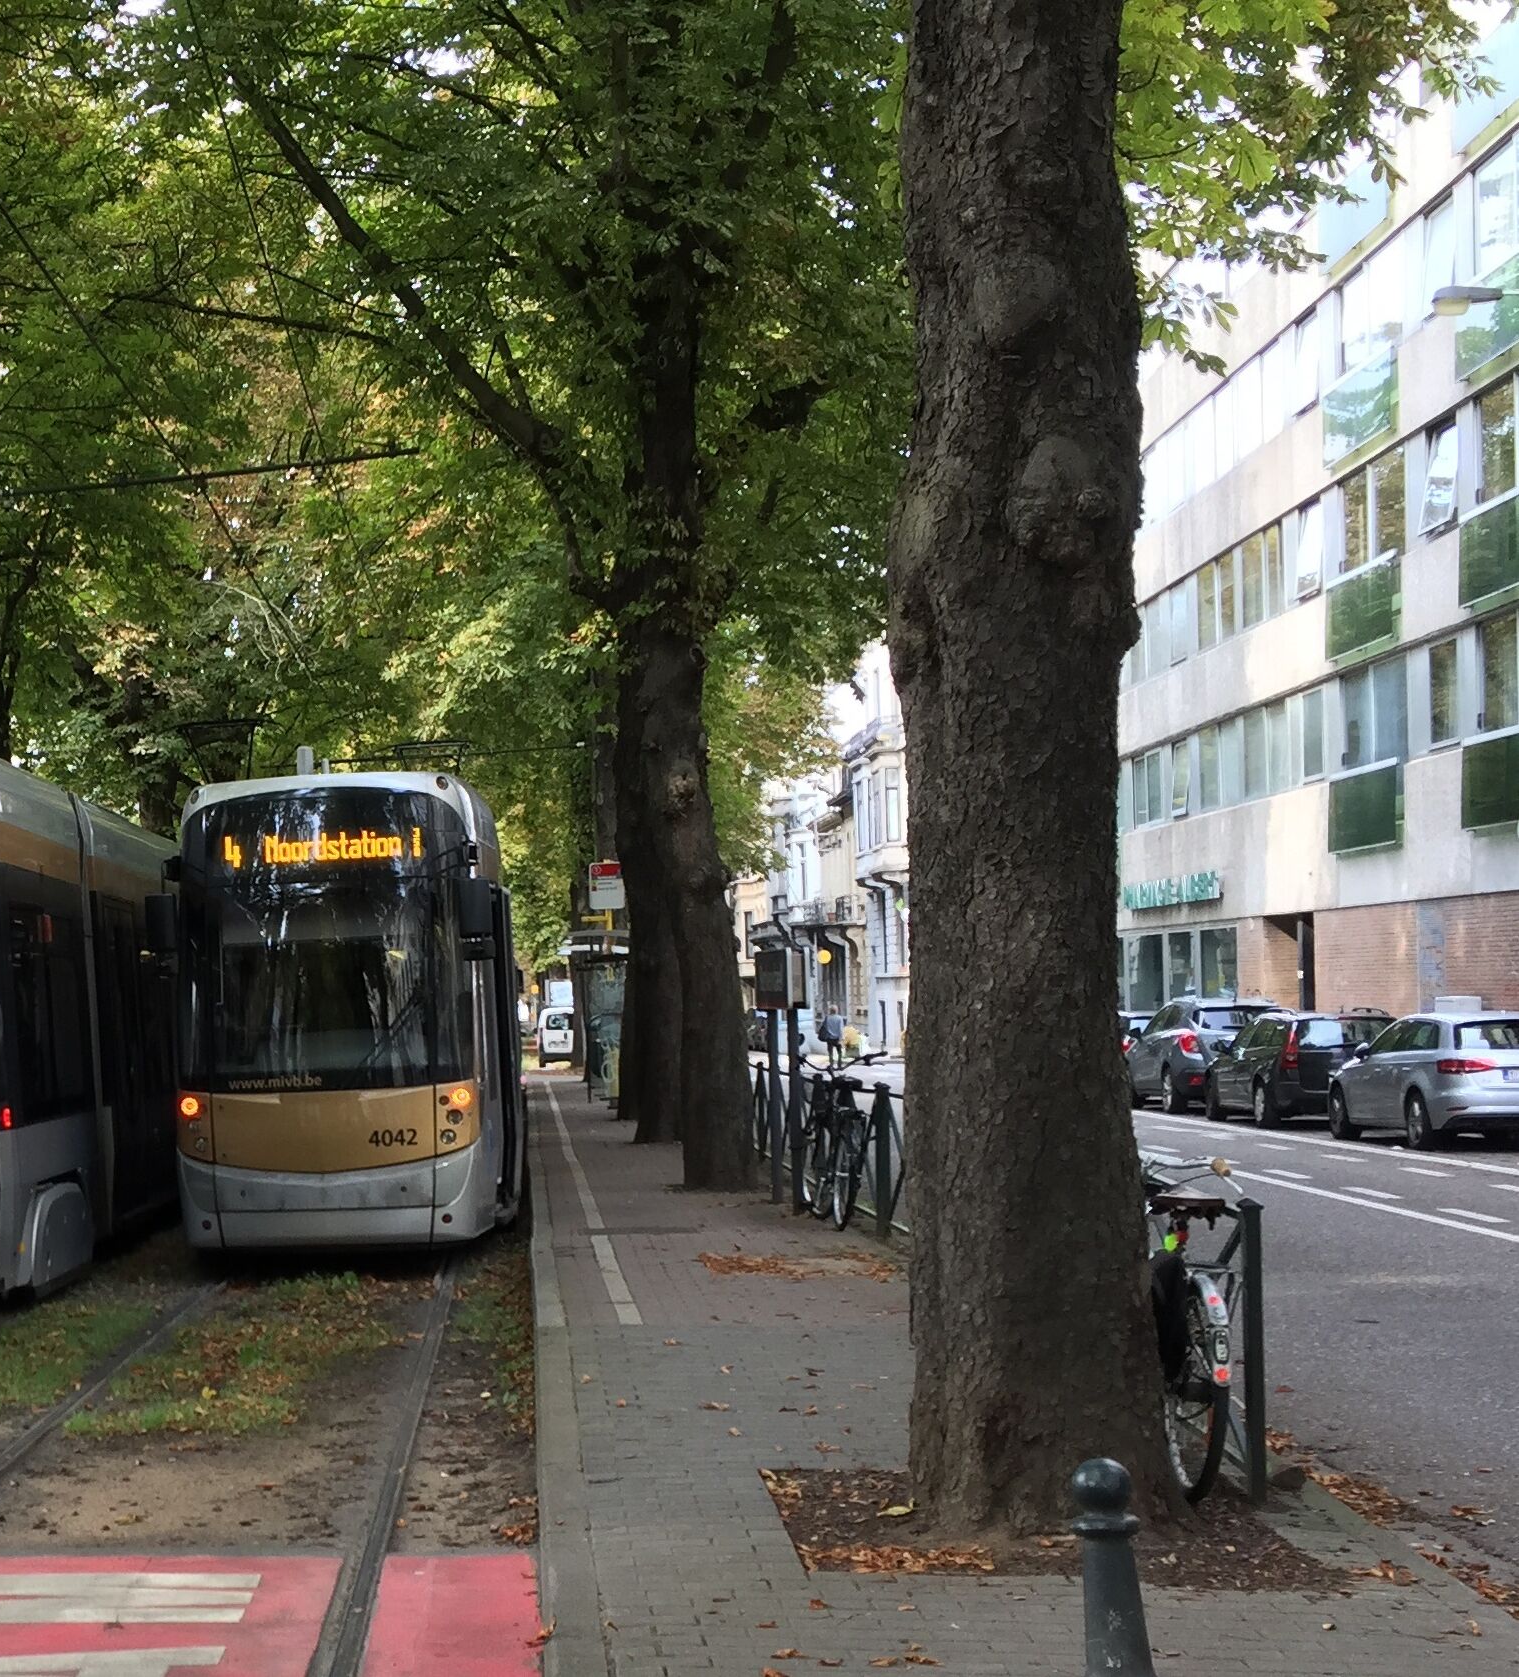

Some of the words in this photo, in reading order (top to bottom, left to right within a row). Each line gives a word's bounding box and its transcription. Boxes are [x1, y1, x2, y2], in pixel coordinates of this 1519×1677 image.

[224, 836, 243, 868] 4
[264, 831, 403, 863] Noordstation
[229, 1074, 322, 1090] www.mivb.be
[368, 1129, 418, 1147] 4042
